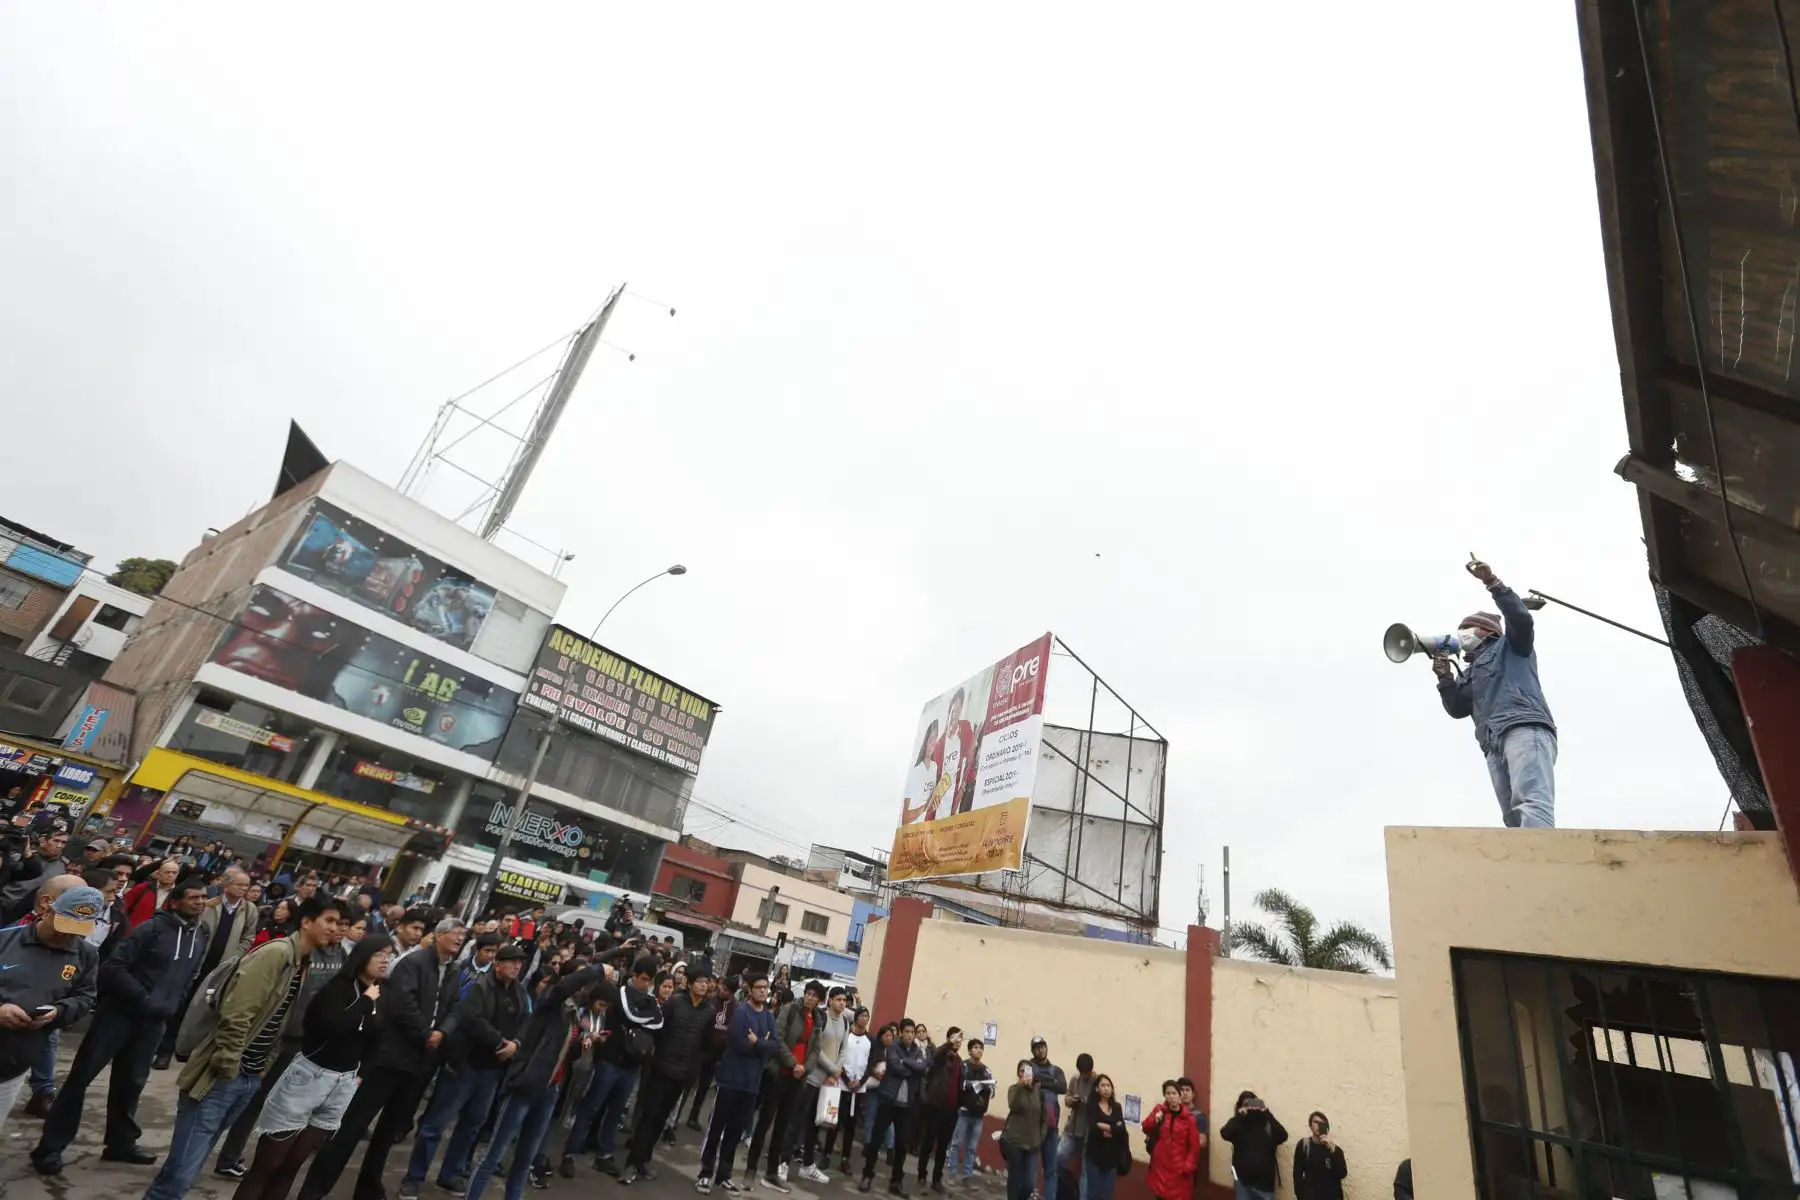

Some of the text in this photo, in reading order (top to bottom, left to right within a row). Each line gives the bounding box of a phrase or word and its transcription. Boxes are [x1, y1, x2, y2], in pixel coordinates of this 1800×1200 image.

[548, 628, 709, 722] ACADEMIA PLAN DE VIDA
[1010, 655, 1040, 695] pre
[582, 685, 630, 717] EXAMEN
[632, 708, 648, 724] DE
[586, 669, 633, 701] GASTE
[638, 693, 656, 712] EN
[661, 703, 695, 729] VANO
[72, 708, 108, 746] TESIS
[541, 683, 562, 702] PRE
[626, 722, 638, 736] A
[643, 729, 664, 746] SU
[667, 739, 700, 762] HIJO
[596, 724, 627, 745] INFORMES
[626, 736, 633, 746] Y
[631, 737, 652, 755] CLASES
[651, 748, 659, 759] EN
[659, 751, 666, 761] EL
[665, 753, 686, 769] PRIMER
[685, 762, 699, 774] PISO
[58, 766, 93, 784] LIBROS
[54, 791, 88, 805] COPIAS
[499, 871, 560, 896] ACADEMIA
